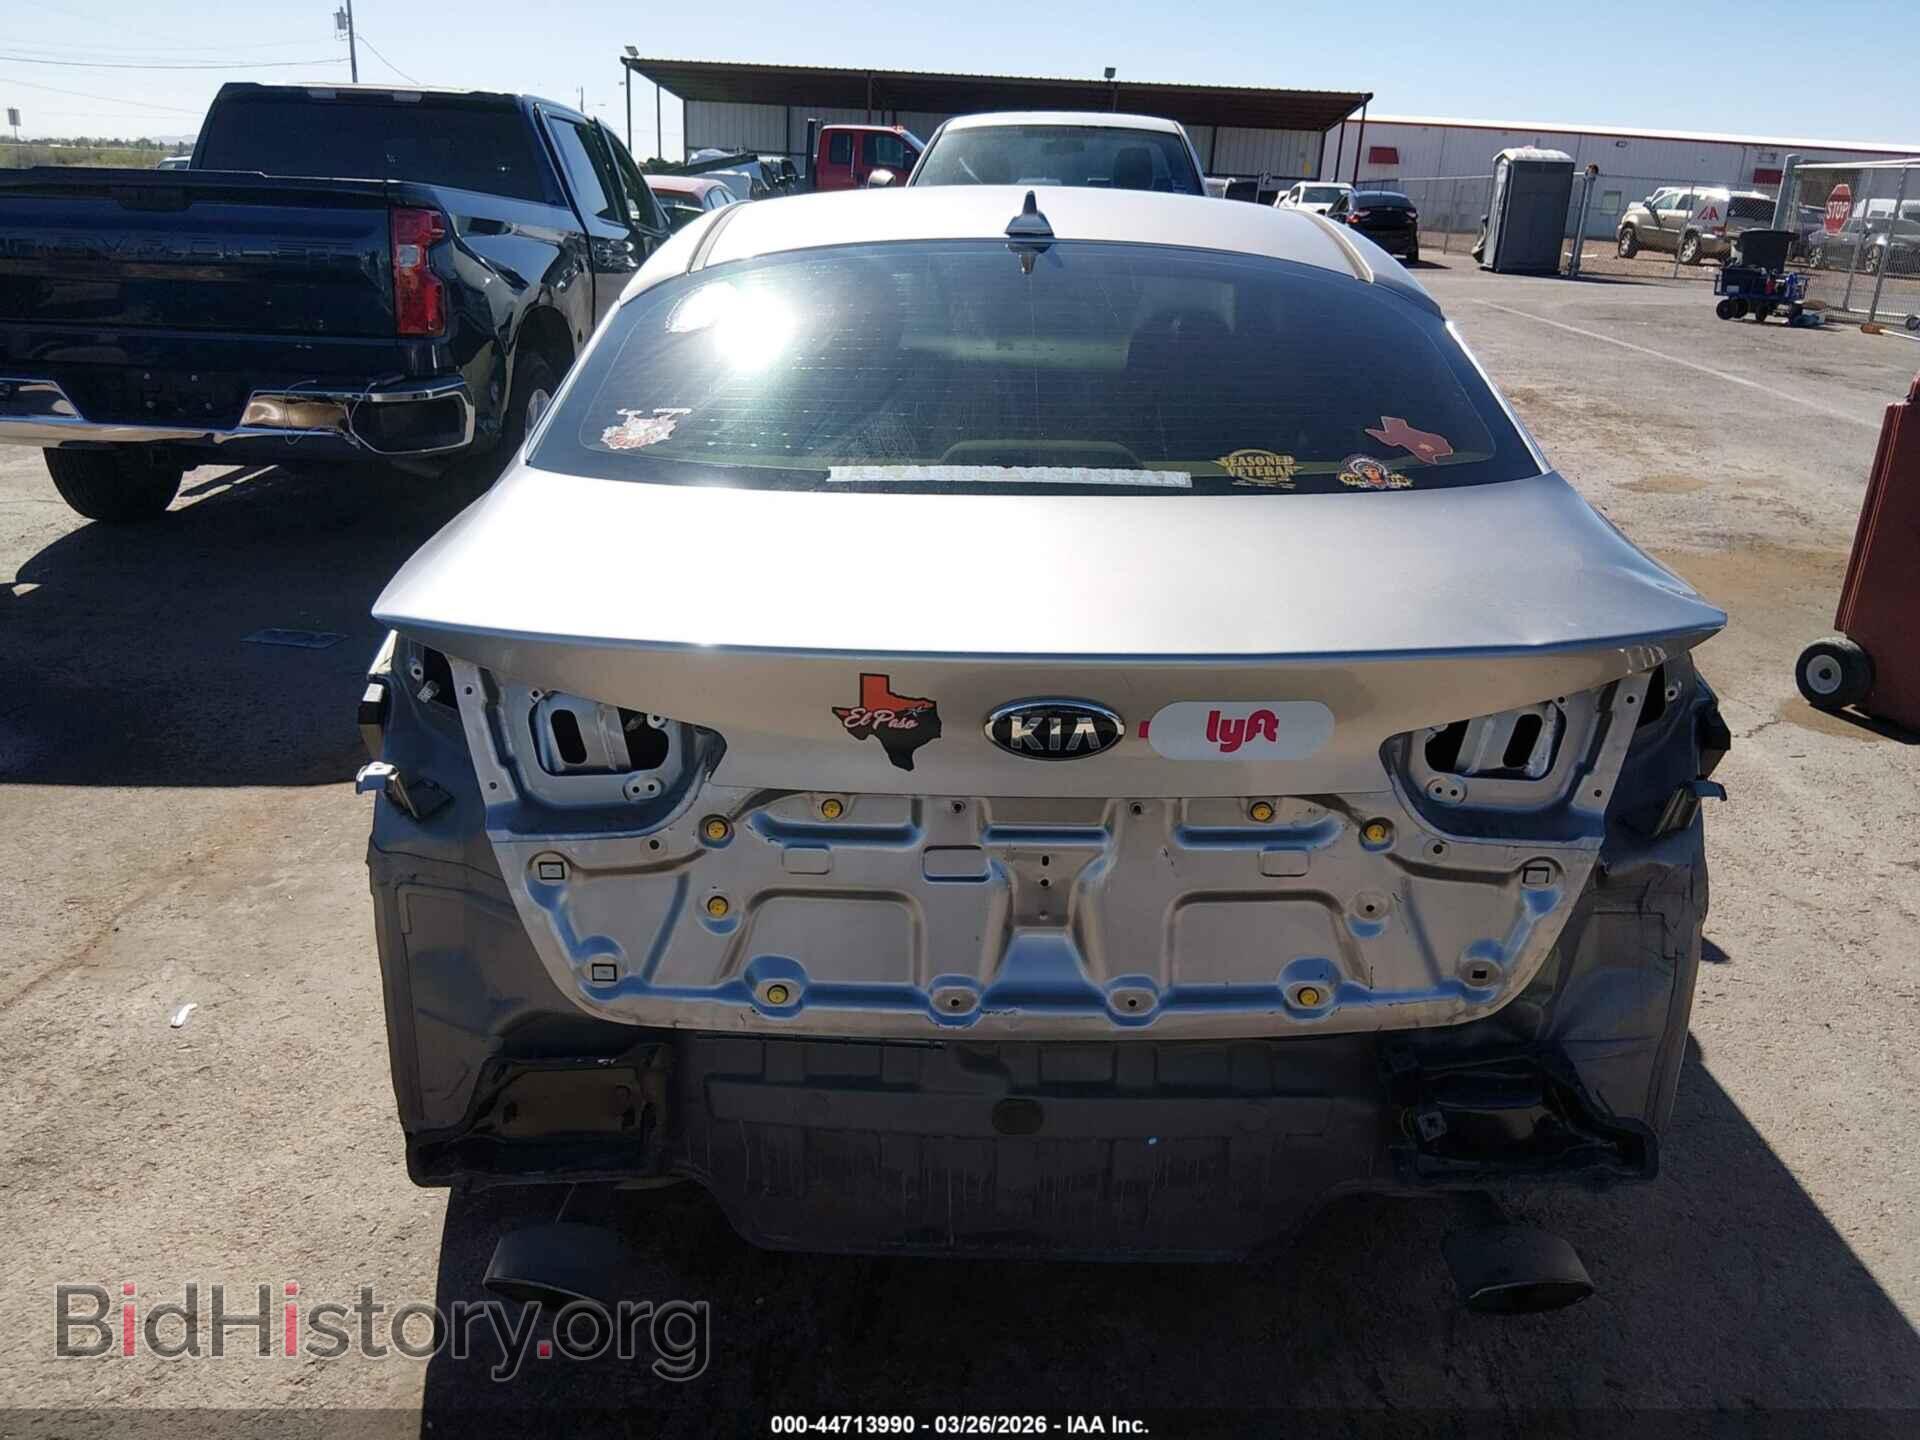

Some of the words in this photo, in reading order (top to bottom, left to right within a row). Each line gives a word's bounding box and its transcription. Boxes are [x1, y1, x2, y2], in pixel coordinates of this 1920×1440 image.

[1826, 201, 1849, 219] STOP
[1221, 455, 1295, 467] SEASONED
[1228, 465, 1294, 477] VETERAN
[844, 707, 873, 728] El
[872, 709, 919, 730] Paso
[1009, 715, 1101, 751] KIA
[1206, 709, 1280, 753] lyft
